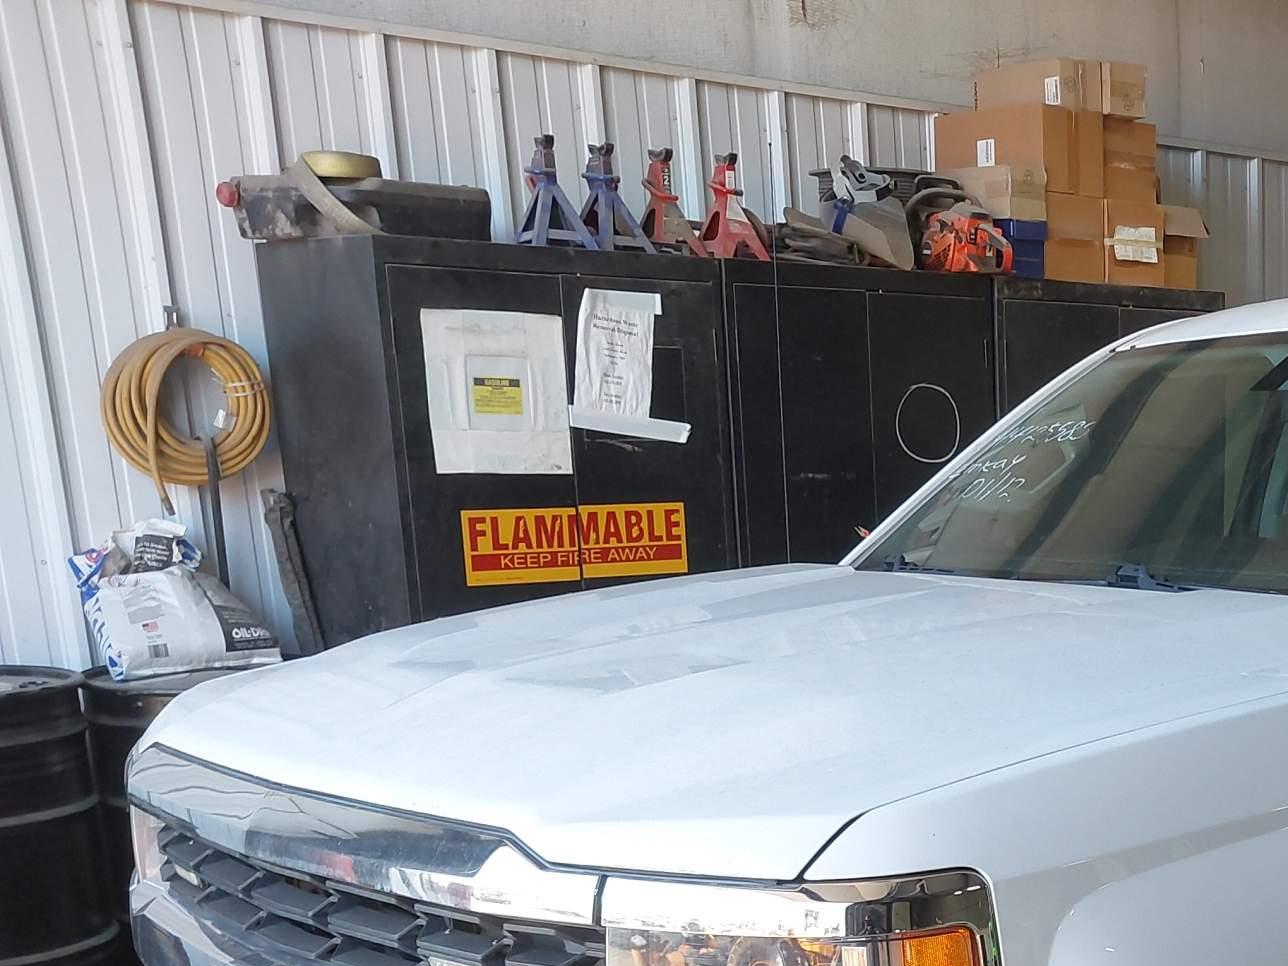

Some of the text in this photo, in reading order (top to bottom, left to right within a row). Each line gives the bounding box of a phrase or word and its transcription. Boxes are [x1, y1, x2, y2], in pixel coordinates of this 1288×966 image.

[467, 508, 683, 553] FLAMMABLE
[500, 546, 657, 569] KEEP FIRE AWAY
[231, 626, 272, 639] OIL-D
